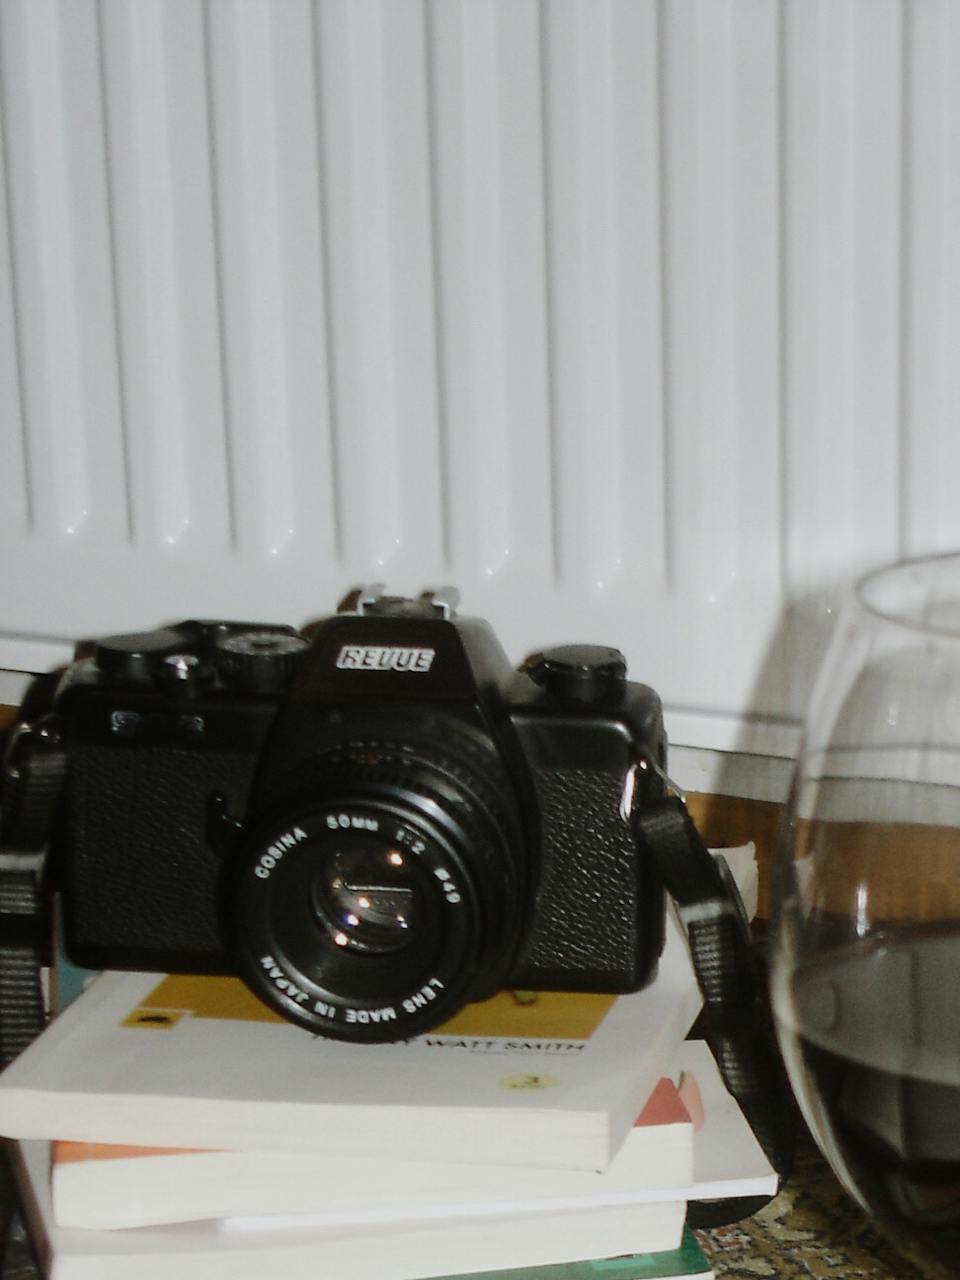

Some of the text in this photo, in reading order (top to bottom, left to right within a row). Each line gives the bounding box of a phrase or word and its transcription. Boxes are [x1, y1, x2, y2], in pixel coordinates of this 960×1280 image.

[336, 645, 435, 672] REVUE
[254, 826, 308, 879] COSINA
[259, 955, 445, 1023] LENS MADE IN JAPAN
[425, 1038, 585, 1051] WATT SMITH
